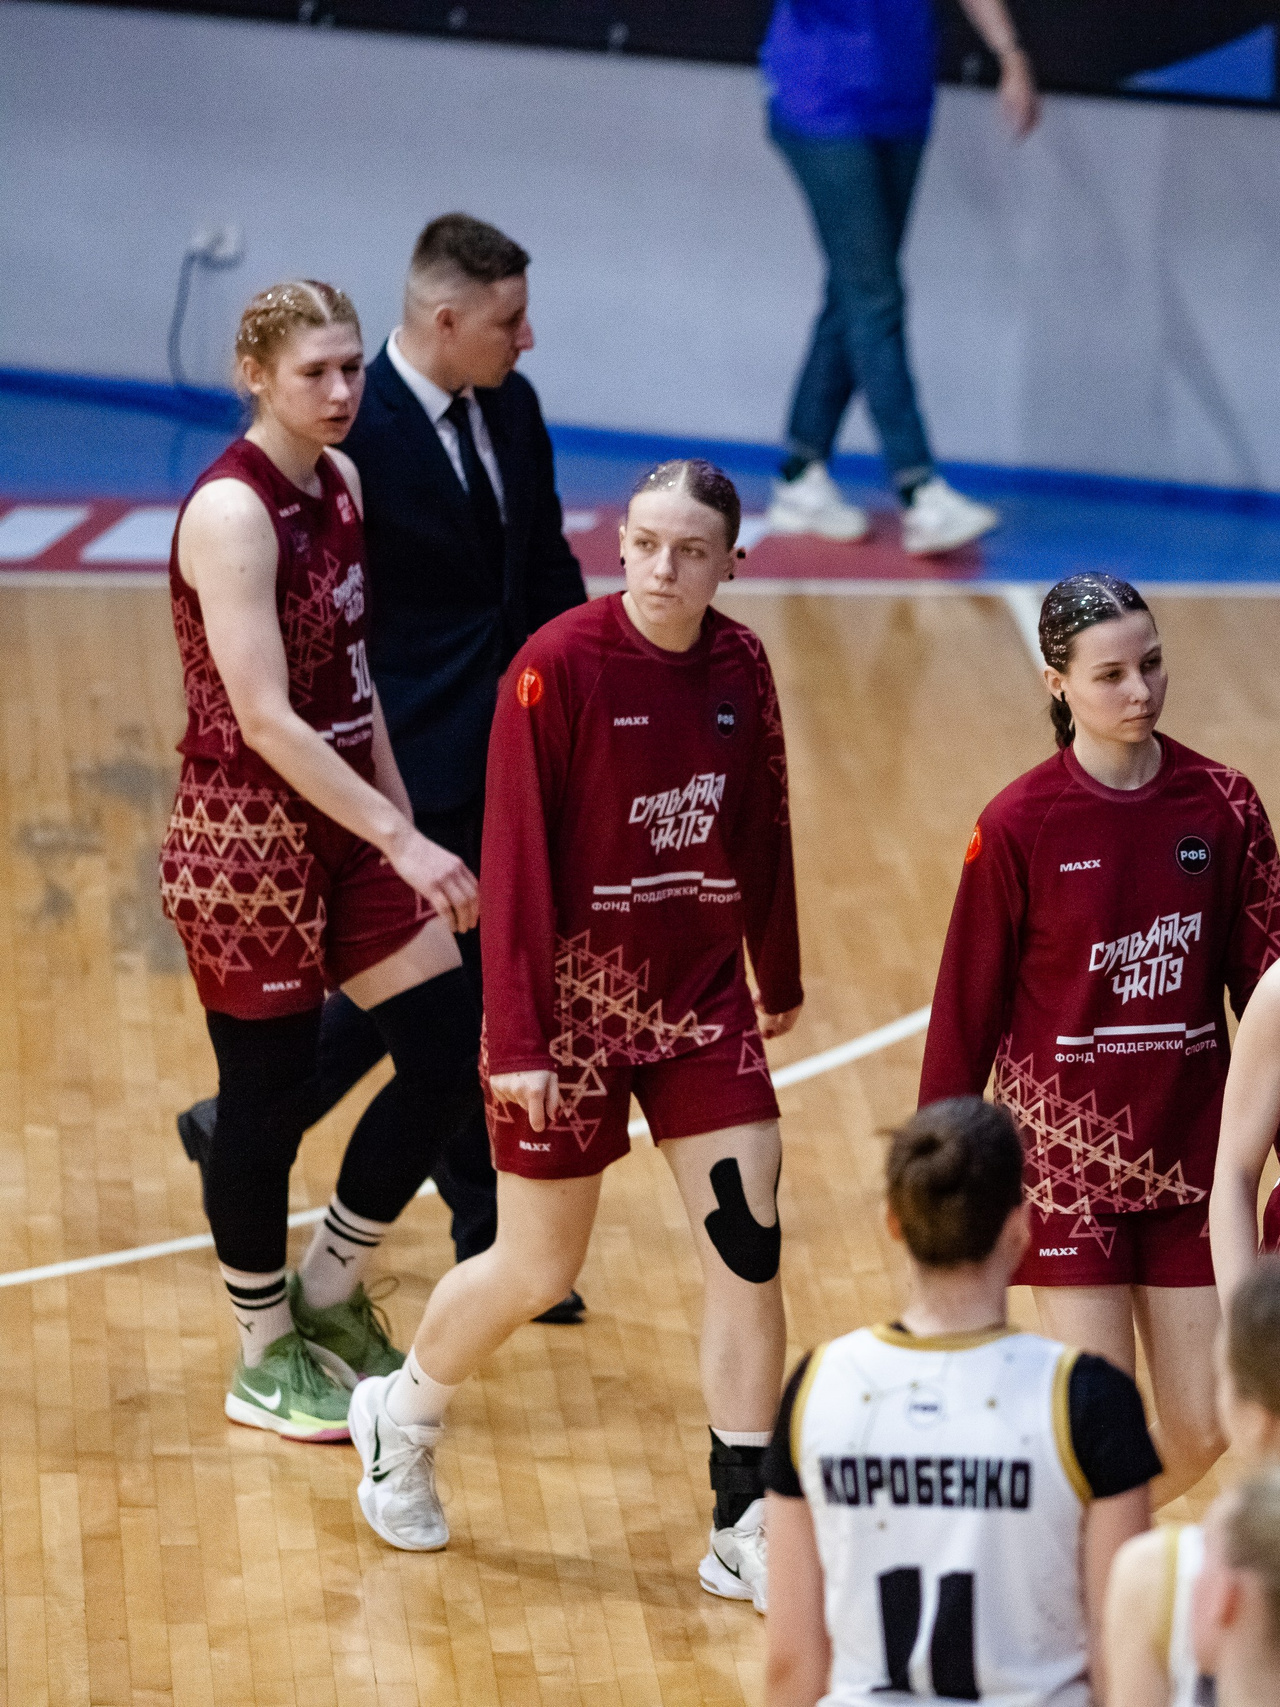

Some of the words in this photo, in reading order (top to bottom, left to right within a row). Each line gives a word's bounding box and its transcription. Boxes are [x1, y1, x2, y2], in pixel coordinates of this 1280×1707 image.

[613, 715, 649, 727] MAXX
[1180, 849, 1207, 861] РФБ
[1059, 859, 1102, 873] MAXX
[591, 901, 630, 912] ФОНД
[633, 885, 699, 903] ПОДДЕРЖКИ
[1111, 952, 1184, 1006] ЧКПЗ
[1054, 1051, 1095, 1064] ФОНД
[1097, 1040, 1184, 1054] ПОДДЕРЖКИ
[1185, 1039, 1218, 1056] СПОРТА
[1039, 1246, 1078, 1257] MAXX
[819, 1457, 1032, 1510] КОРОБЕНКО
